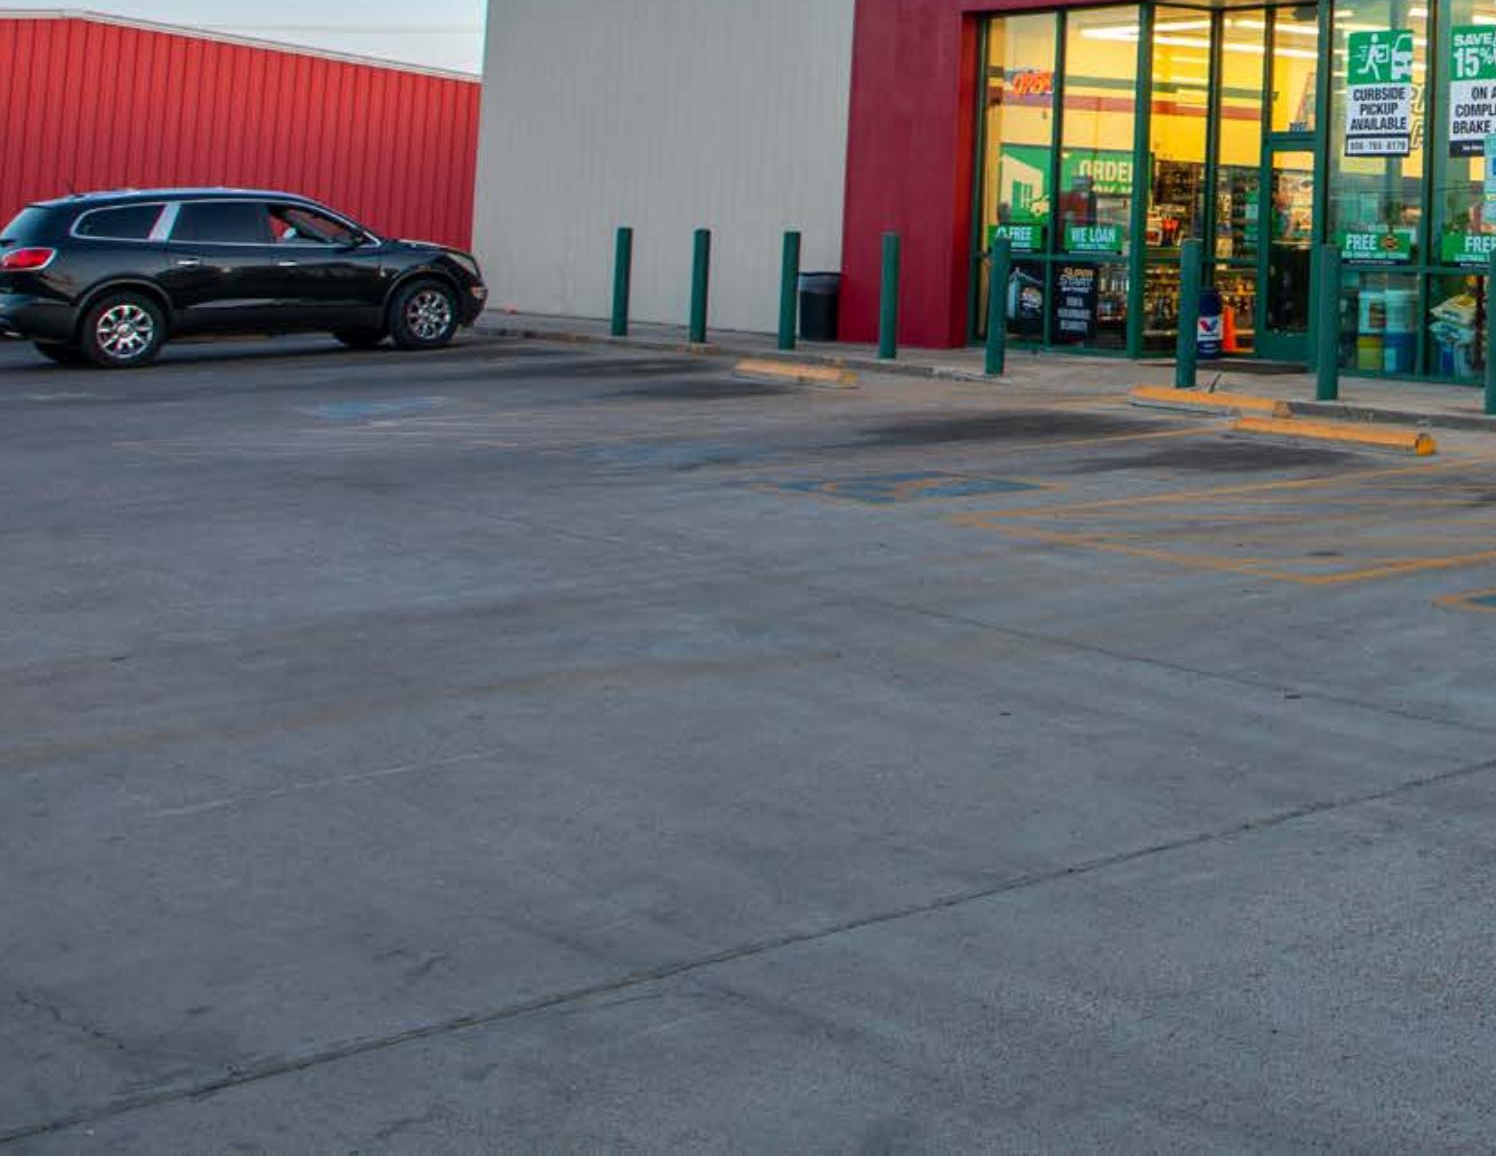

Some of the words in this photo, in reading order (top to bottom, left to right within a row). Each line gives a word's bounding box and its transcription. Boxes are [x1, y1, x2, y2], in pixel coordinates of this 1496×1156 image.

[1453, 33, 1492, 46] SAVE
[1453, 47, 1494, 77] 15%
[1353, 87, 1406, 101] CURBSIDE
[1471, 86, 1488, 100] ON
[1360, 102, 1398, 115] PICKUP
[1350, 116, 1407, 131] AVAILABLE
[1453, 119, 1490, 134] BRAKE
[1008, 226, 1032, 241] FREE
[1072, 226, 1087, 242] WE
[1088, 226, 1116, 243] LOAN
[1346, 235, 1377, 251] FREE
